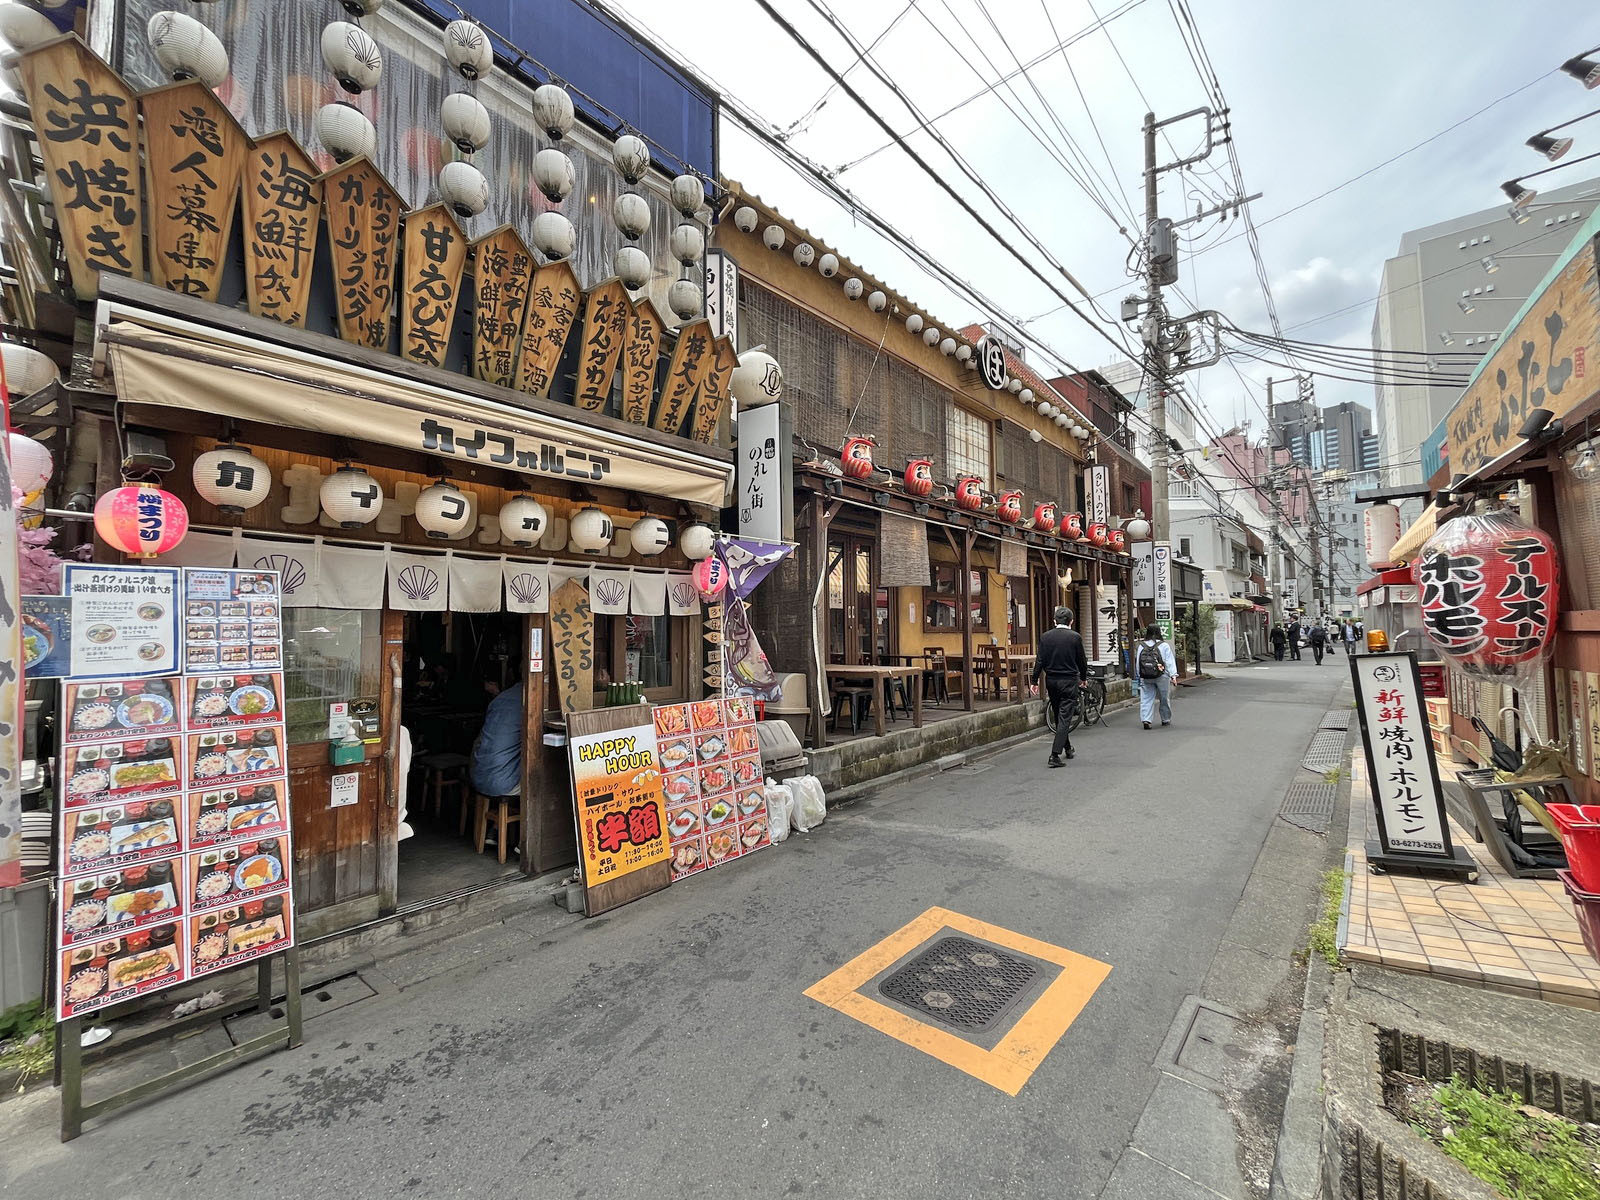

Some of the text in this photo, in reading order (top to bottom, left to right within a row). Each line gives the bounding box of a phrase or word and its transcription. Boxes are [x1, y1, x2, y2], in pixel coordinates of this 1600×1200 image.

[420, 418, 611, 480] カイフォルニア
[748, 446, 768, 510] のれん街
[1420, 551, 1489, 656] ホルモン
[1493, 537, 1549, 657] テールスープ
[579, 736, 636, 762] HAPPY
[605, 750, 652, 775] HOUR
[597, 801, 662, 854] 半額
[1390, 838, 1443, 851] 03-6273-2529
